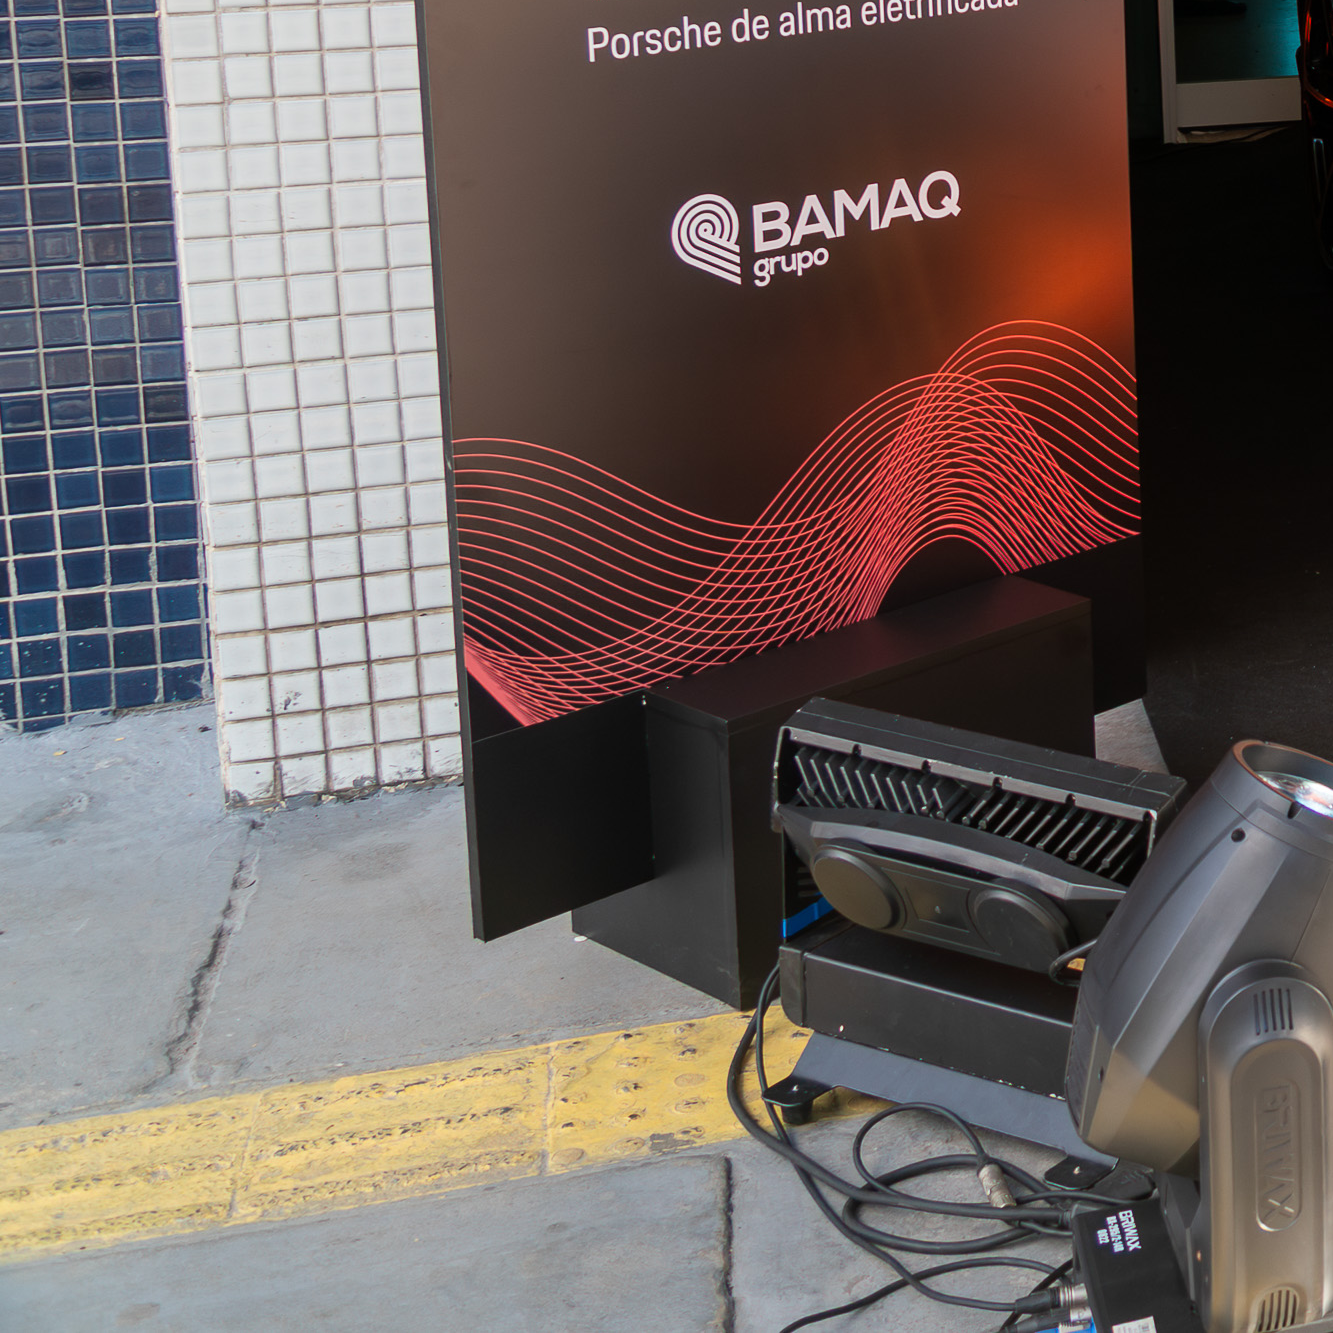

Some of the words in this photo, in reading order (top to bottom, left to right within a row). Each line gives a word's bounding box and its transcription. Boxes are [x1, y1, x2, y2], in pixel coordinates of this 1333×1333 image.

[587, 16, 722, 63] Porsche
[730, 9, 770, 43] de
[778, 1, 852, 38] alma
[752, 170, 961, 253] BAMAQ
[753, 245, 829, 287] grupo
[1118, 1209, 1142, 1252] BRIWAX
